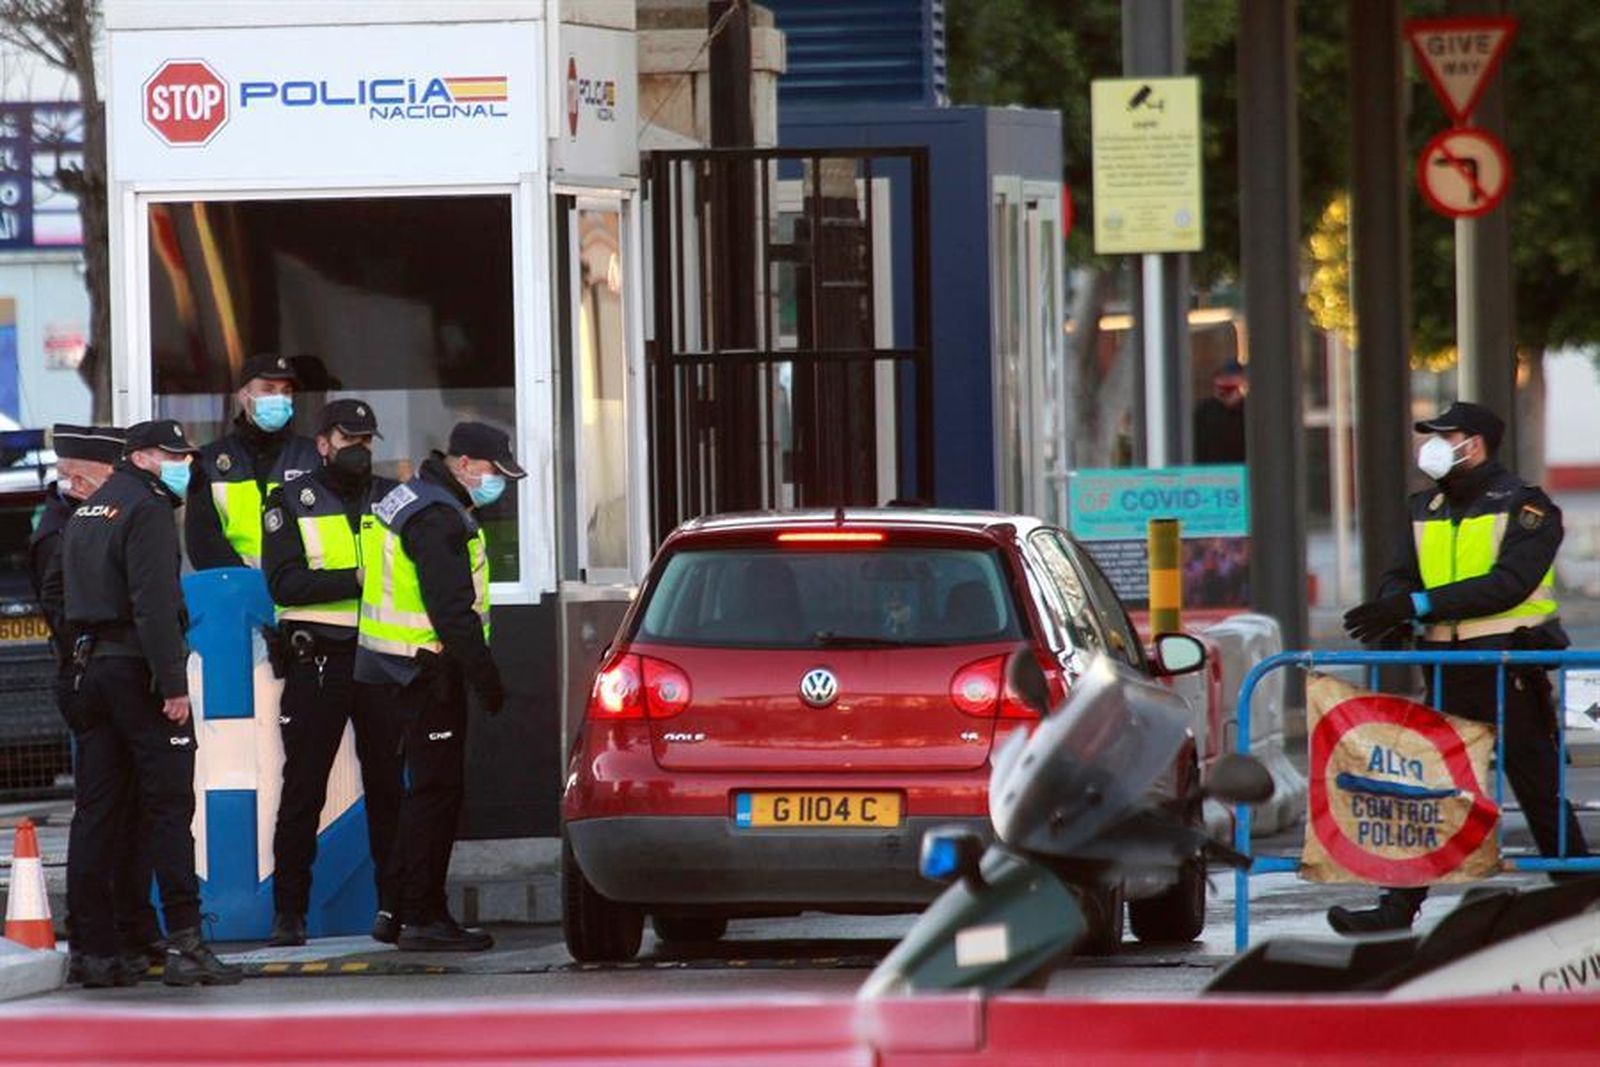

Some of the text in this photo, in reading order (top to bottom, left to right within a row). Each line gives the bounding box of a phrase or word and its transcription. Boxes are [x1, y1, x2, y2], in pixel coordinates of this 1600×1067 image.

[1426, 34, 1491, 55] GIVE
[1443, 60, 1481, 75] WAY
[151, 84, 221, 122] STOP
[369, 103, 508, 120] NACIONAL
[1120, 488, 1240, 512] COVID-19
[773, 797, 877, 822] G 1104 C
[1352, 794, 1444, 824] CONTROL
[1358, 821, 1438, 849] POLICIA
